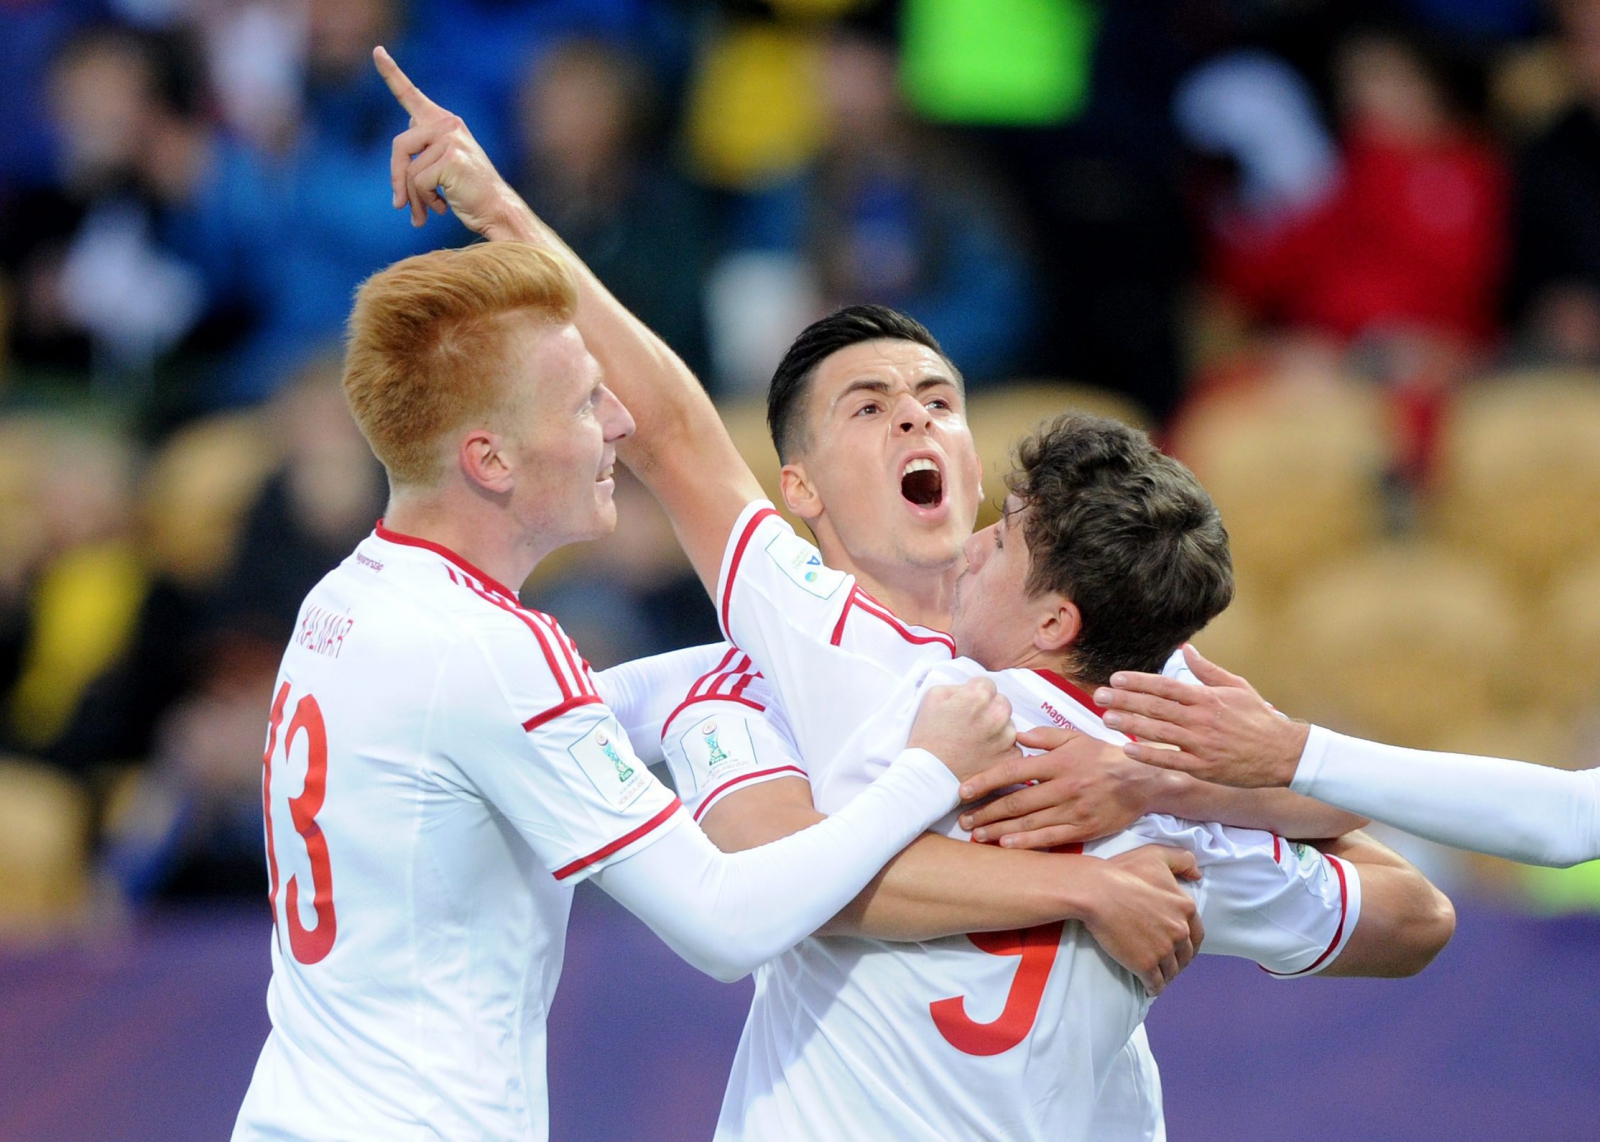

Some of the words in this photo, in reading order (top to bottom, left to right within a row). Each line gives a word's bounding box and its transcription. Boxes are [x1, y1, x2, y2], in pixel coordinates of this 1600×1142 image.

[296, 604, 354, 659] KALMÁR
[262, 681, 338, 965] 13
[929, 832, 1084, 1056] 9
